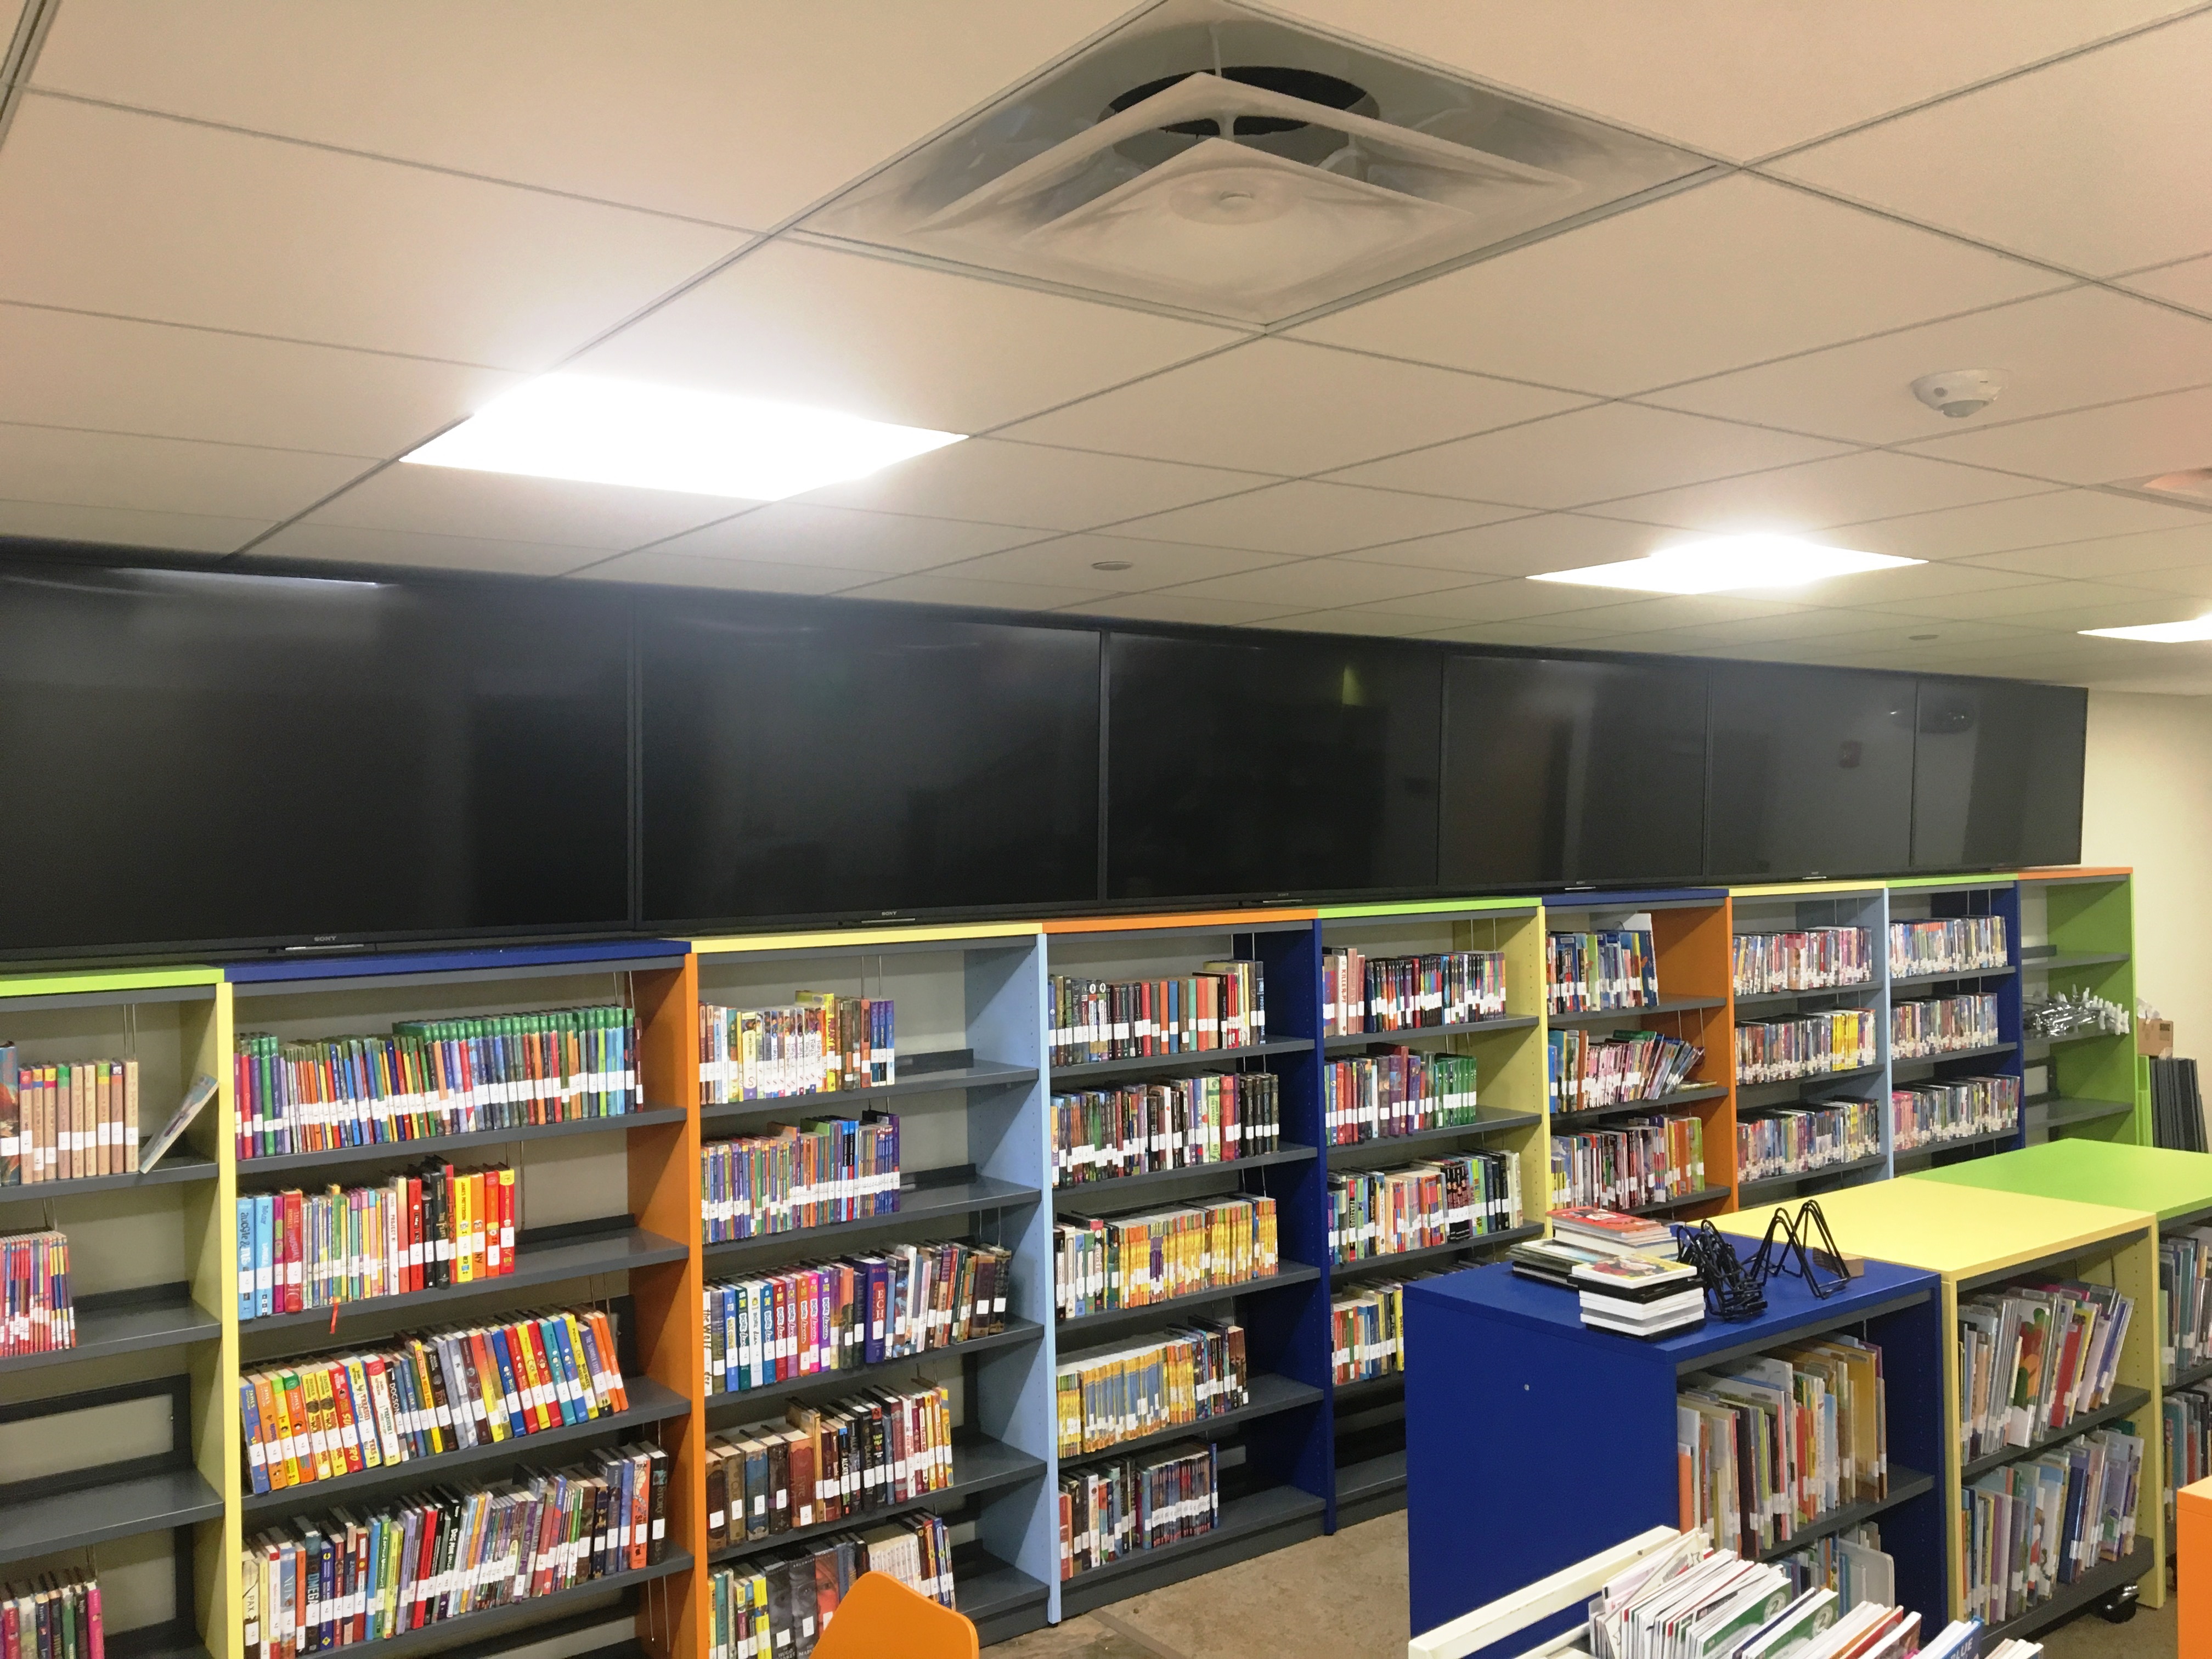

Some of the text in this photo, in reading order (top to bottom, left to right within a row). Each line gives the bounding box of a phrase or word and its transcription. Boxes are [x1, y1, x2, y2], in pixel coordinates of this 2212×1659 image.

[941, 1256, 951, 1279] HOLES
[584, 1335, 600, 1374] THE SUMMER EXPER
[247, 1389, 256, 1407] JAMES
[262, 1385, 271, 1404] JAMES
[387, 1382, 402, 1414] DOGSON
[359, 1394, 370, 1420] TREASU
[796, 1475, 806, 1497] Fyre
[654, 1486, 664, 1514] STORY
[449, 1527, 458, 1541] DOG
[307, 1573, 319, 1605] OMEGA
[246, 1595, 255, 1612] PAX
[1770, 1599, 1781, 1614] 2
[1819, 1612, 1828, 1627] 2
[778, 1649, 793, 1657] HUGO
